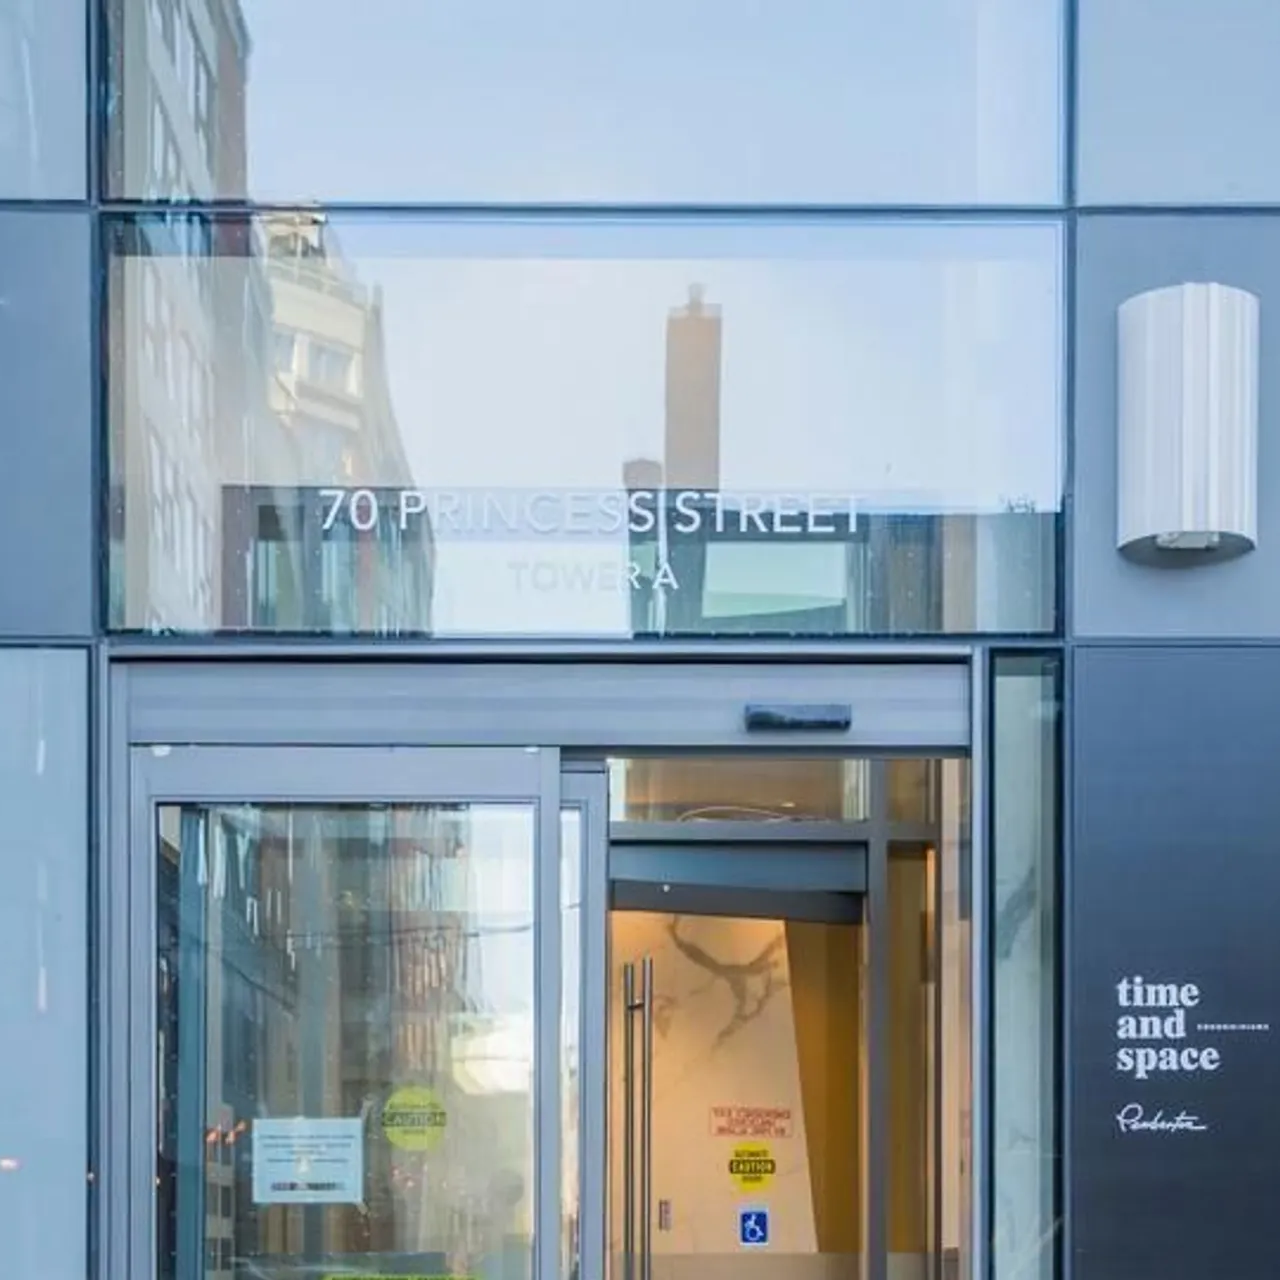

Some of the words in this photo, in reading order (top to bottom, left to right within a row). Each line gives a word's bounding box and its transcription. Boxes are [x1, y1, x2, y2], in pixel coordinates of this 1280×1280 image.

[320, 490, 379, 531] 70
[399, 490, 654, 533] PRINCESS
[674, 490, 862, 534] STREET
[508, 561, 640, 593] TOWER
[652, 561, 679, 591] A
[1116, 975, 1200, 1007] time
[1116, 1008, 1187, 1039] and
[1116, 1046, 1221, 1080] space
[732, 1160, 773, 1173] CAUTION
